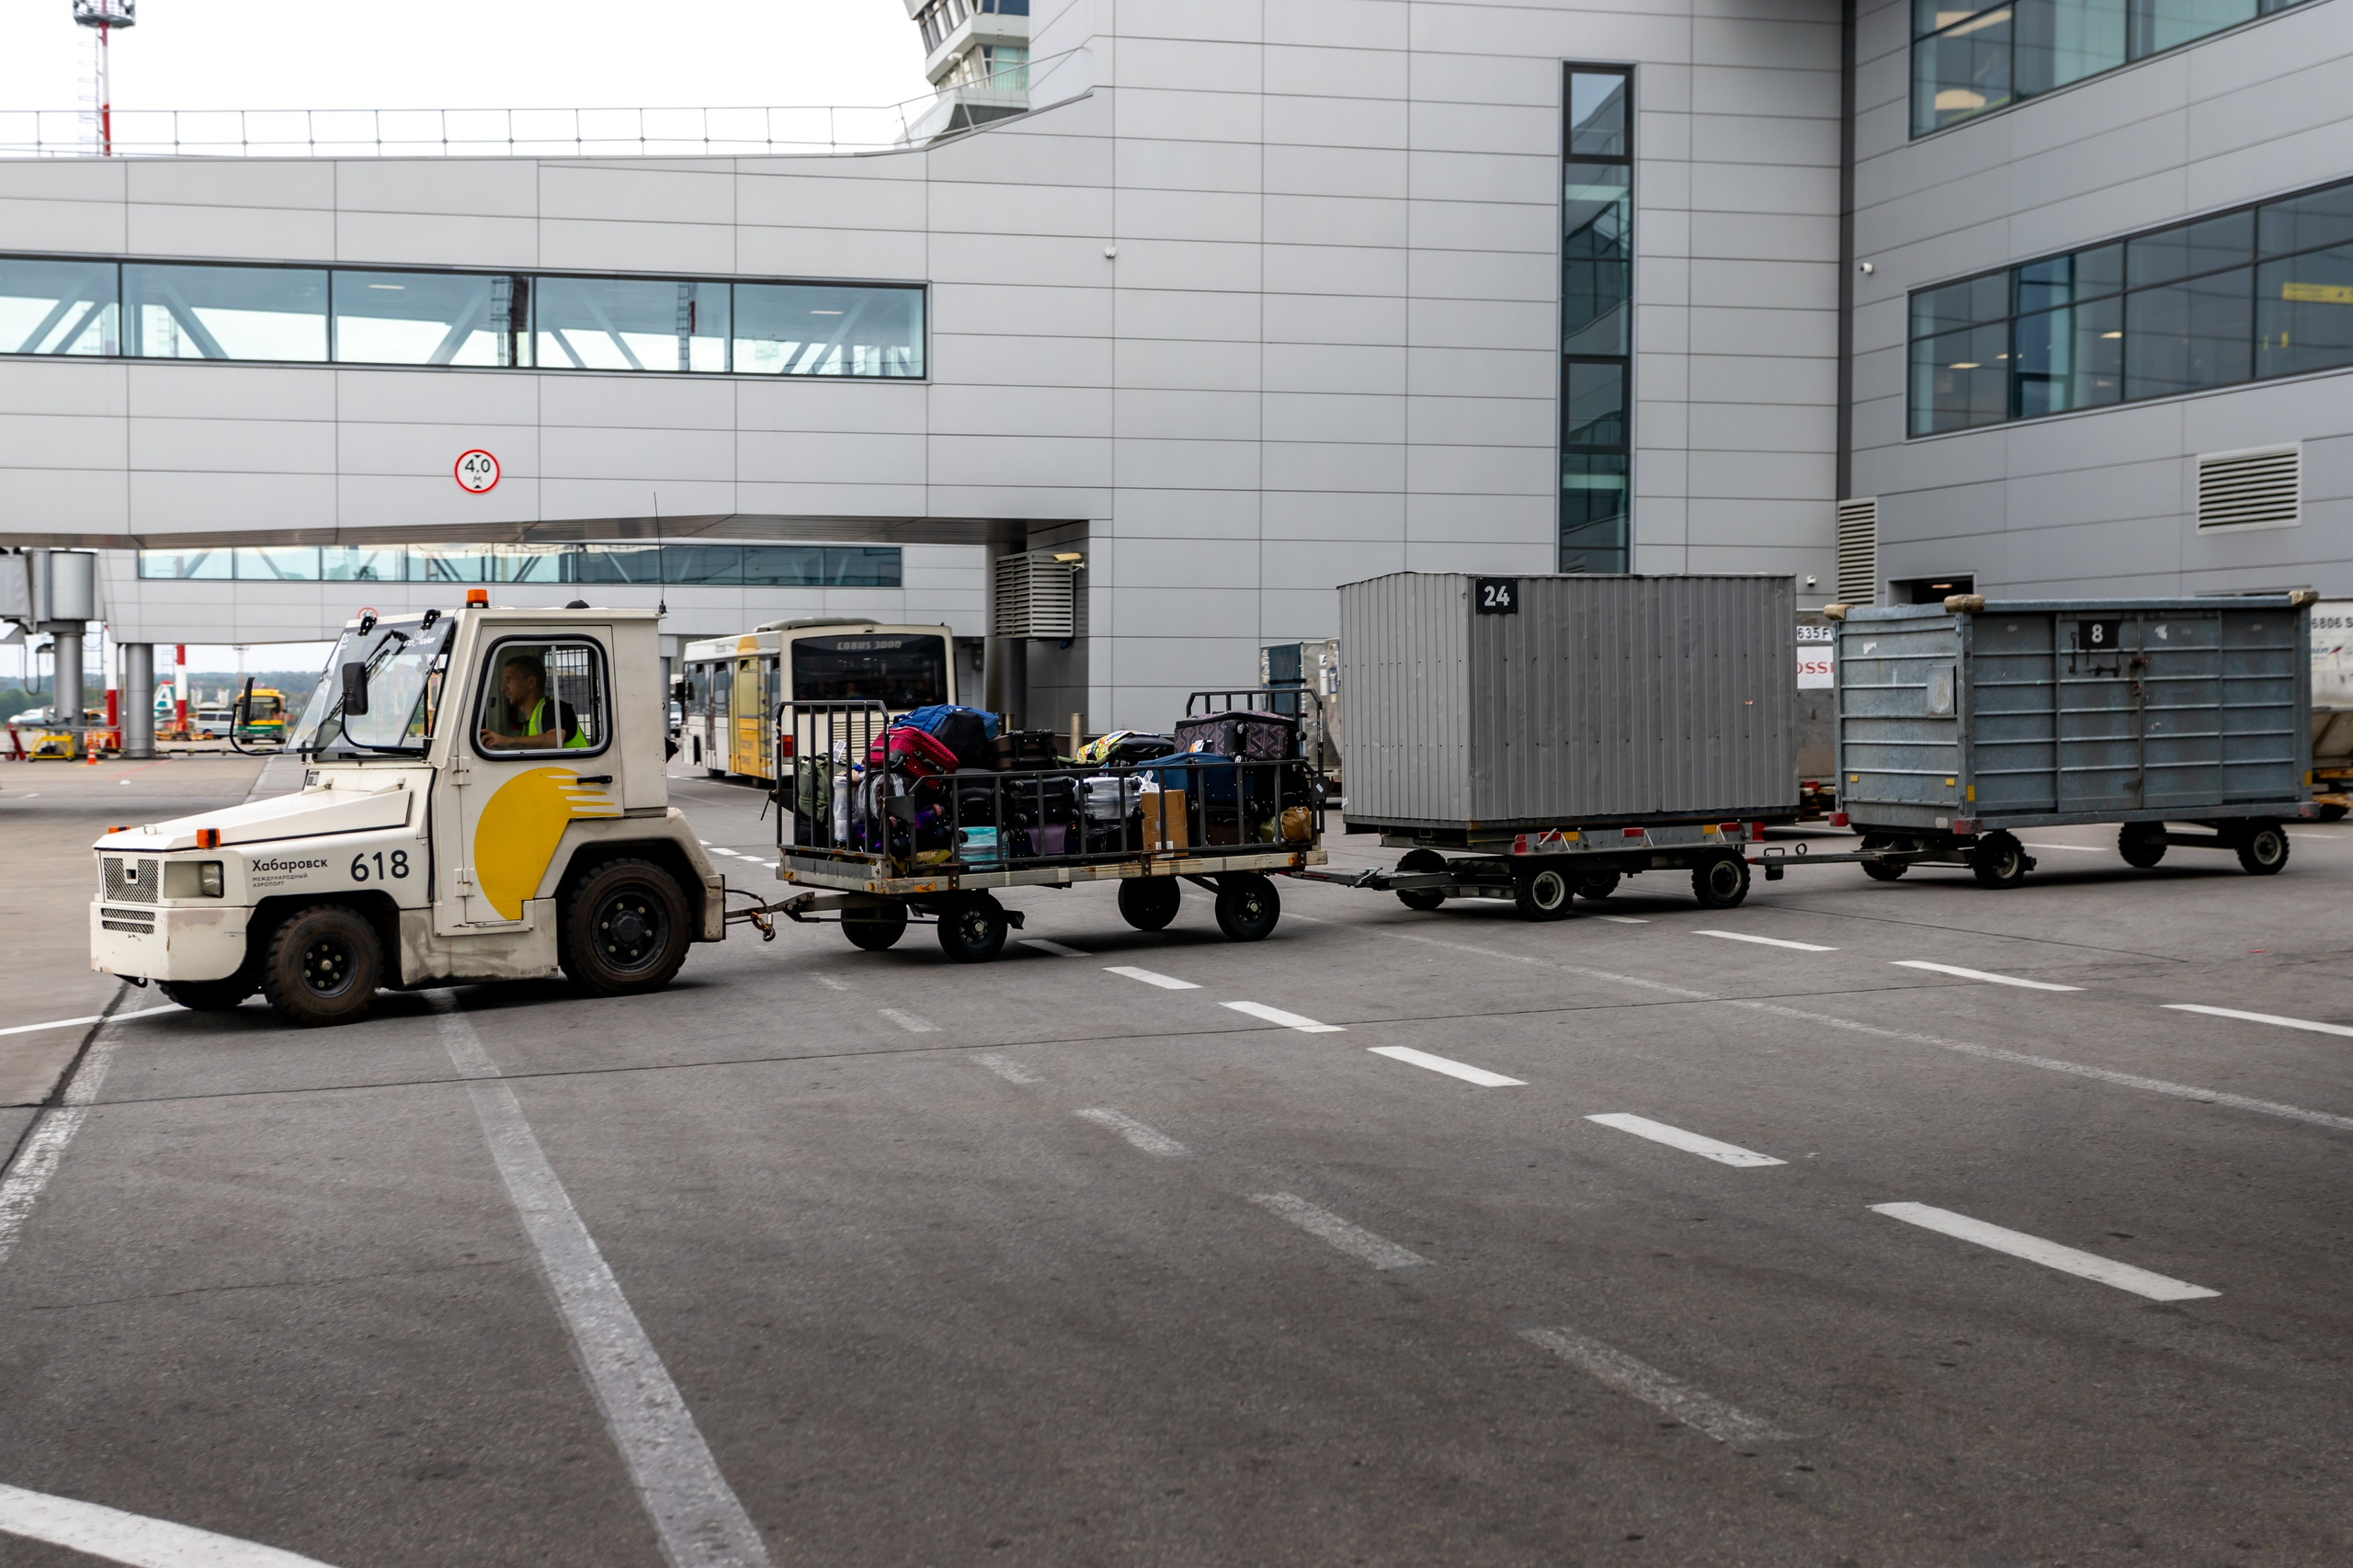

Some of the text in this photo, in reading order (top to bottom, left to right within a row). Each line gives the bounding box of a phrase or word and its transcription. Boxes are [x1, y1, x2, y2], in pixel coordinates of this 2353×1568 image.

[1483, 585, 1510, 607] 24
[2091, 623, 2104, 643] 8
[873, 640, 903, 650] 3000
[252, 858, 329, 873] Хабаровск
[350, 849, 410, 882] 618
[252, 873, 308, 882] МЕЖДУНАРОДНЫЙ
